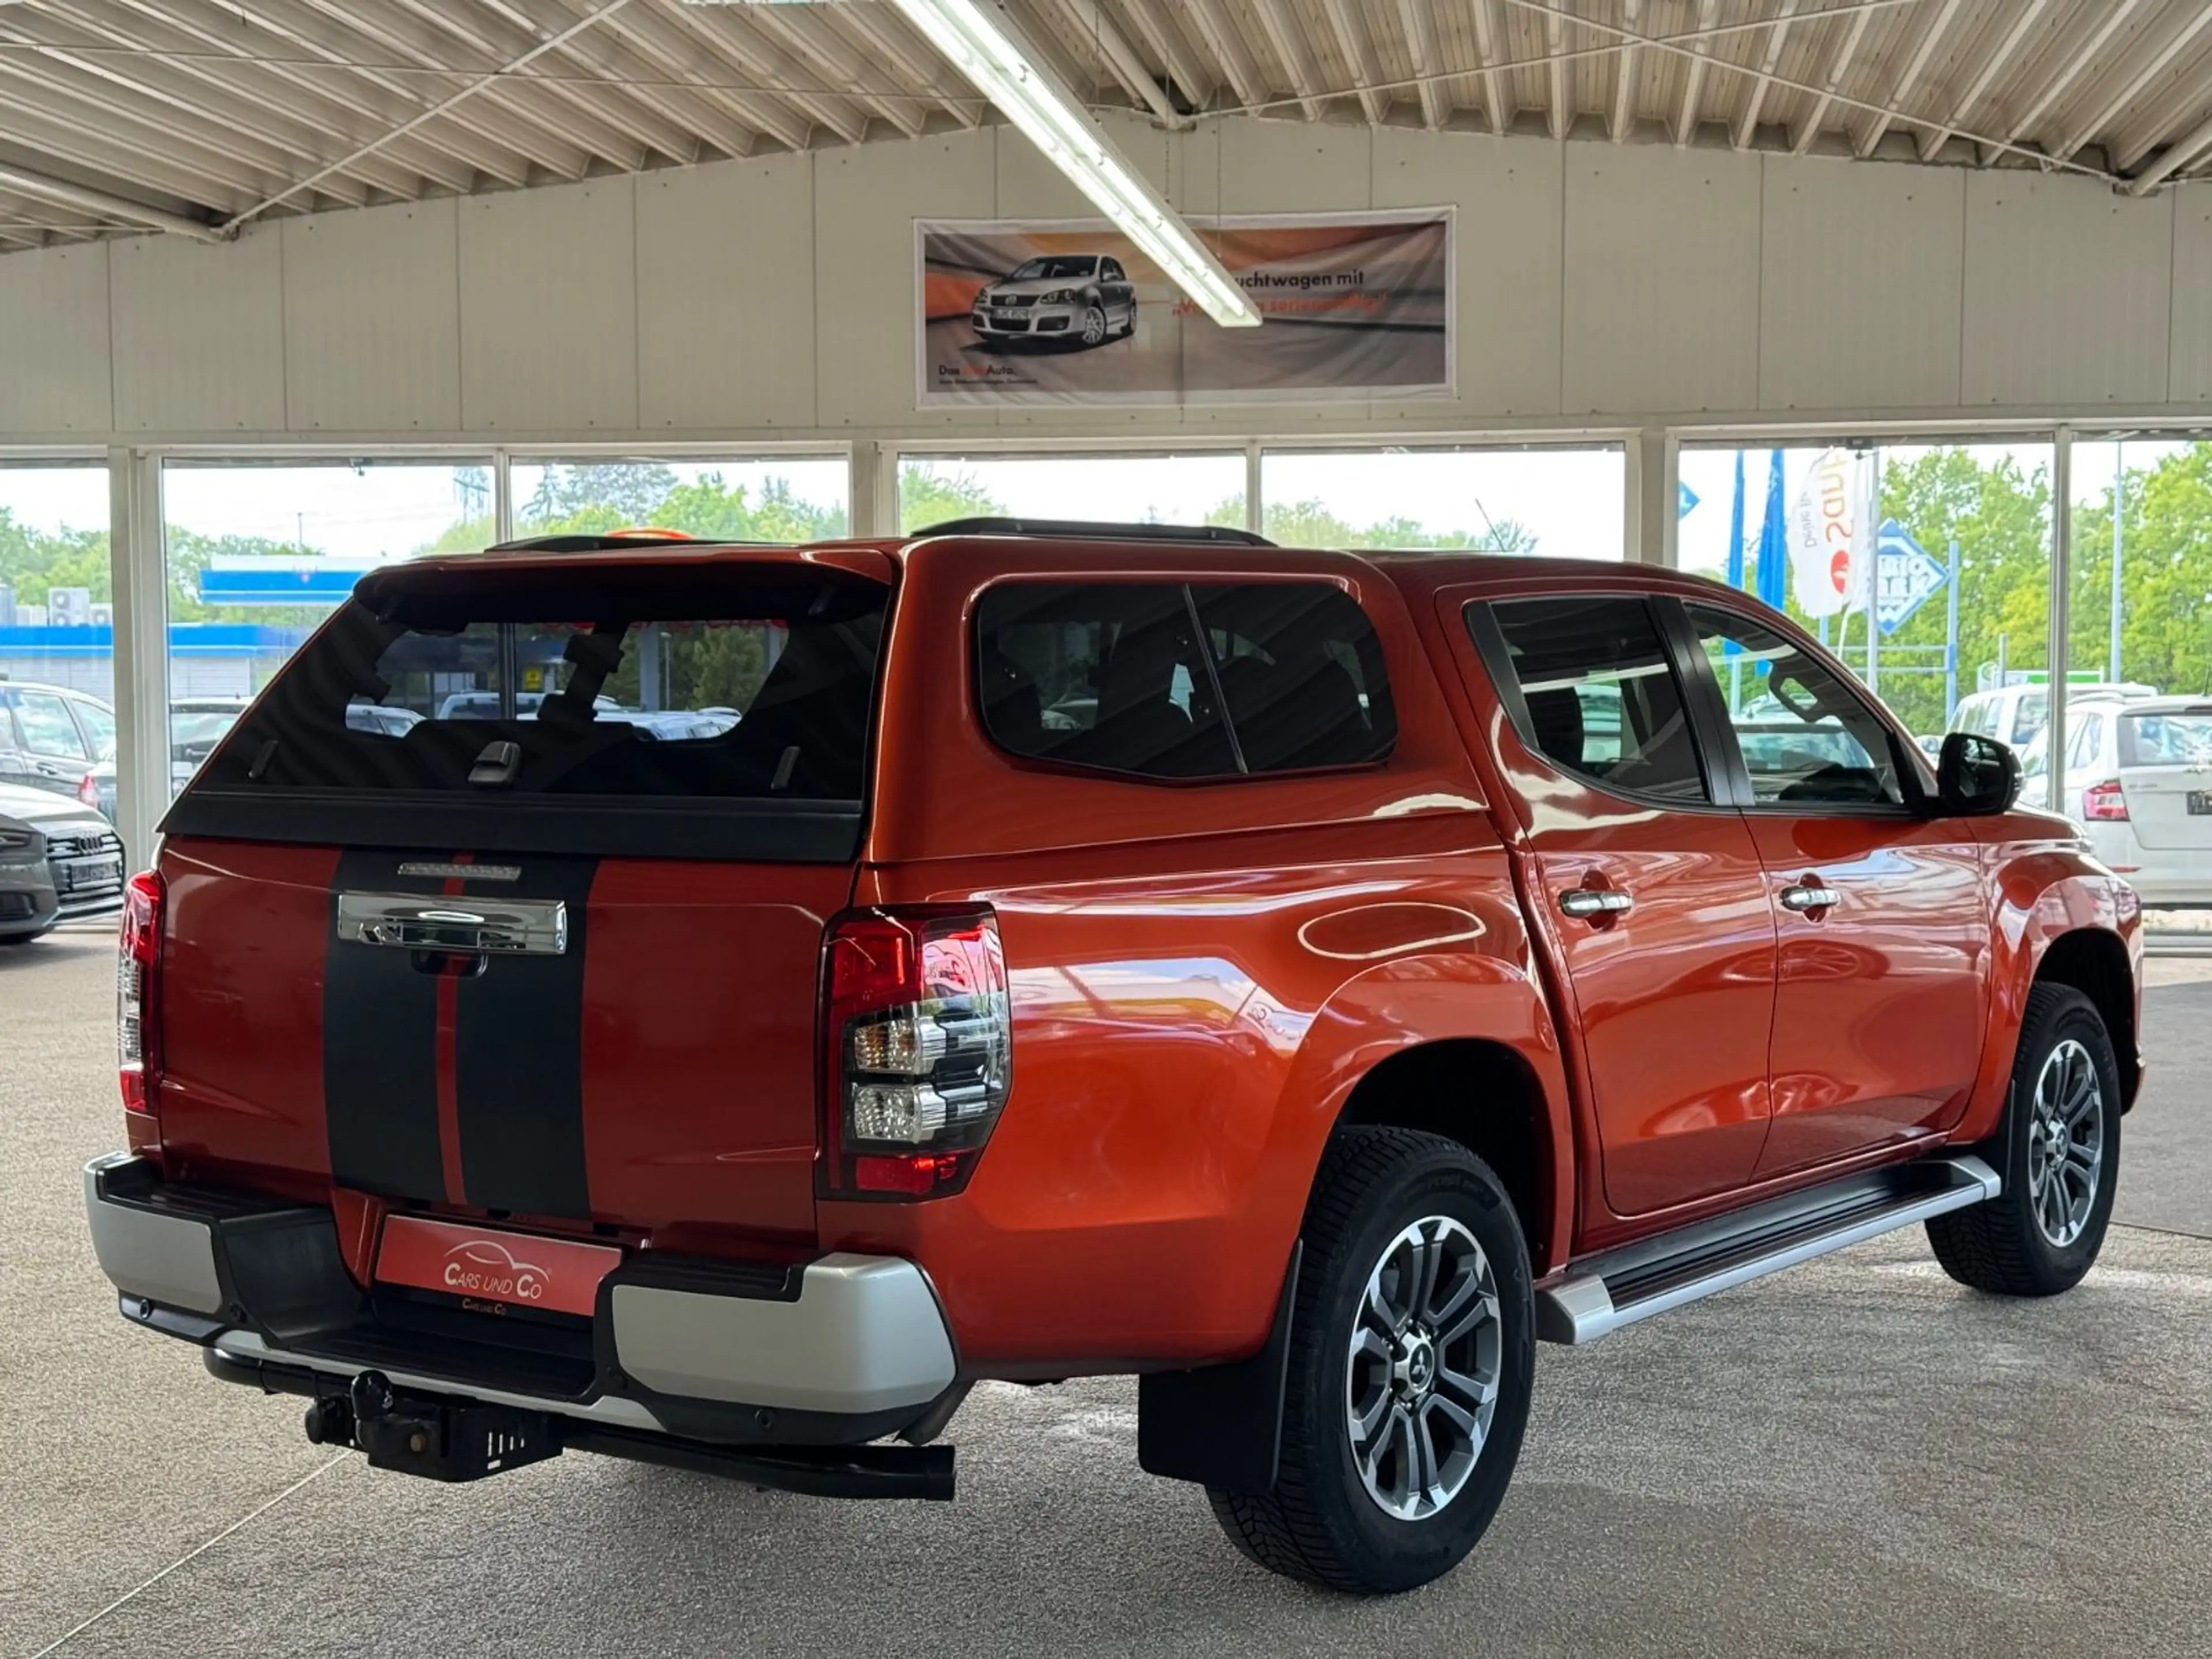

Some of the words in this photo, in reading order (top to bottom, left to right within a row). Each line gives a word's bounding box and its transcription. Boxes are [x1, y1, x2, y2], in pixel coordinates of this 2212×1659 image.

[1336, 269, 1364, 285] mit
[444, 1262, 481, 1290] CARS
[483, 1276, 513, 1294] UND
[517, 1274, 542, 1300] CO
